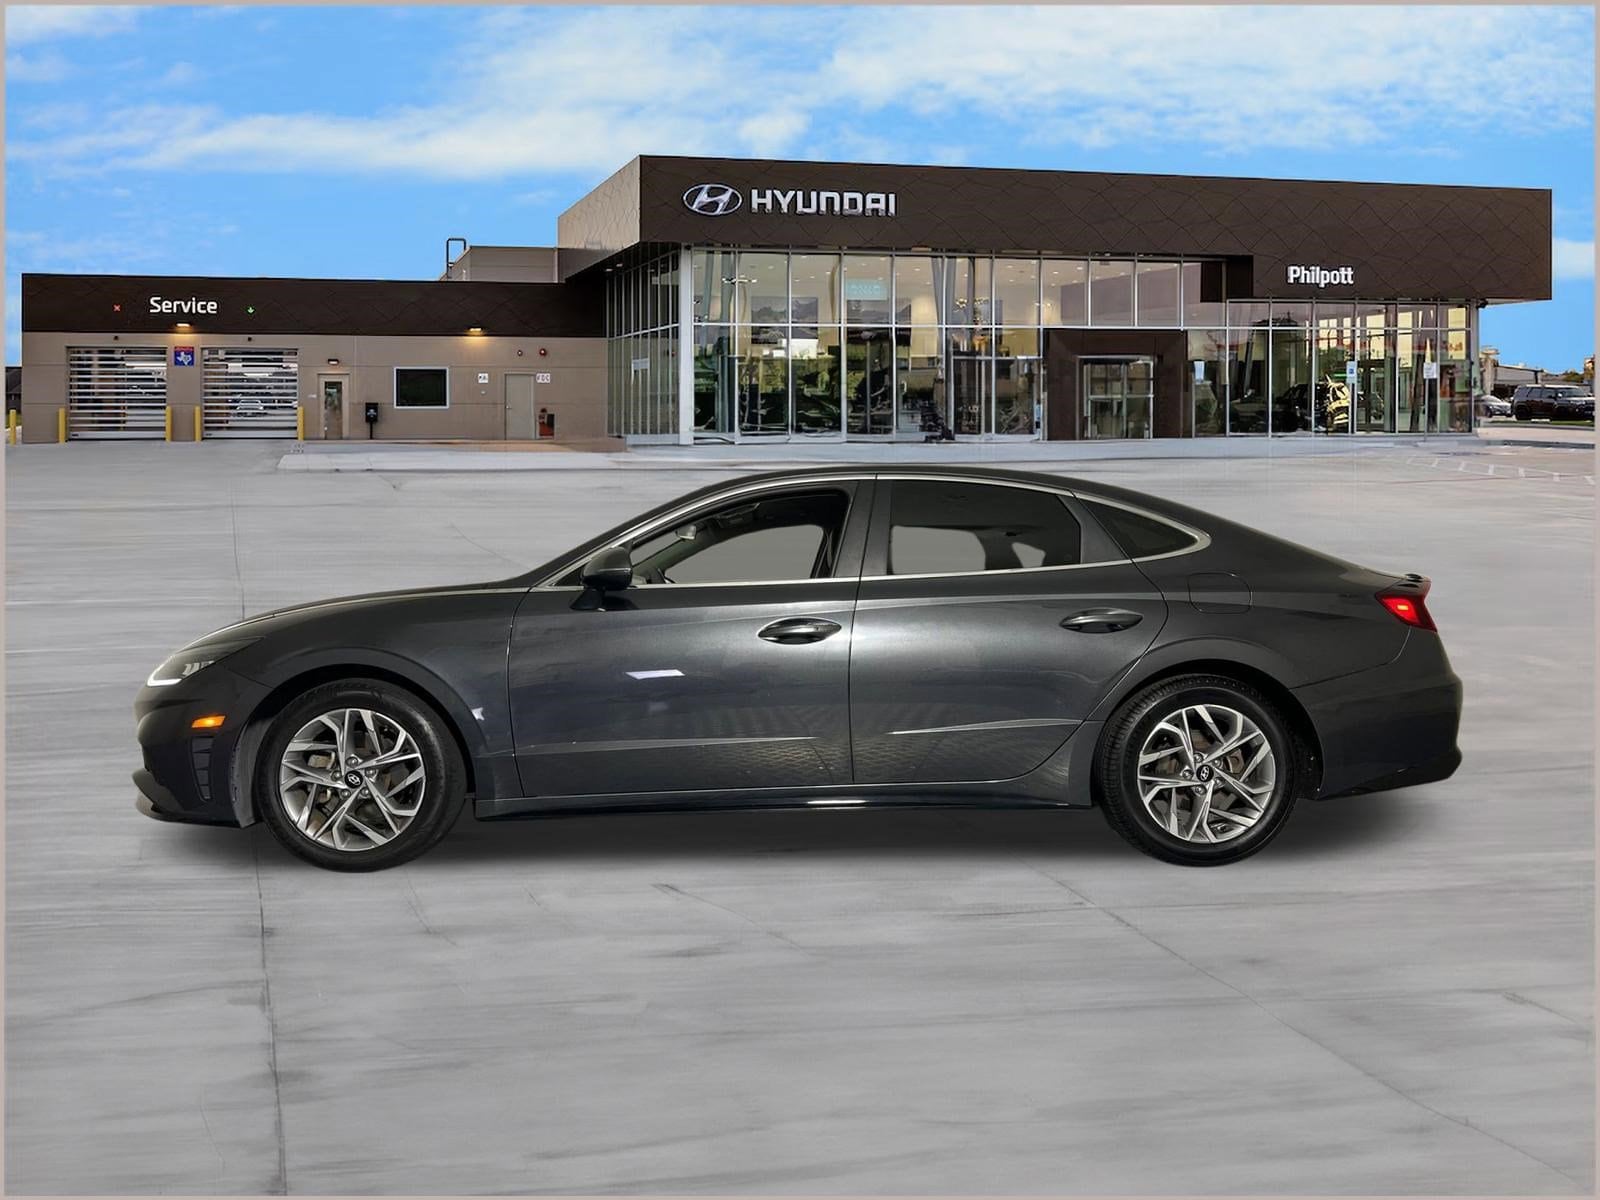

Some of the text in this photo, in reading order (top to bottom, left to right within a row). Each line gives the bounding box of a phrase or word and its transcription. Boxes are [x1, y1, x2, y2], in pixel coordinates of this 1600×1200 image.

[751, 189, 896, 216] HYUNDAI
[1287, 265, 1354, 288] Philpott
[149, 296, 218, 314] Service
